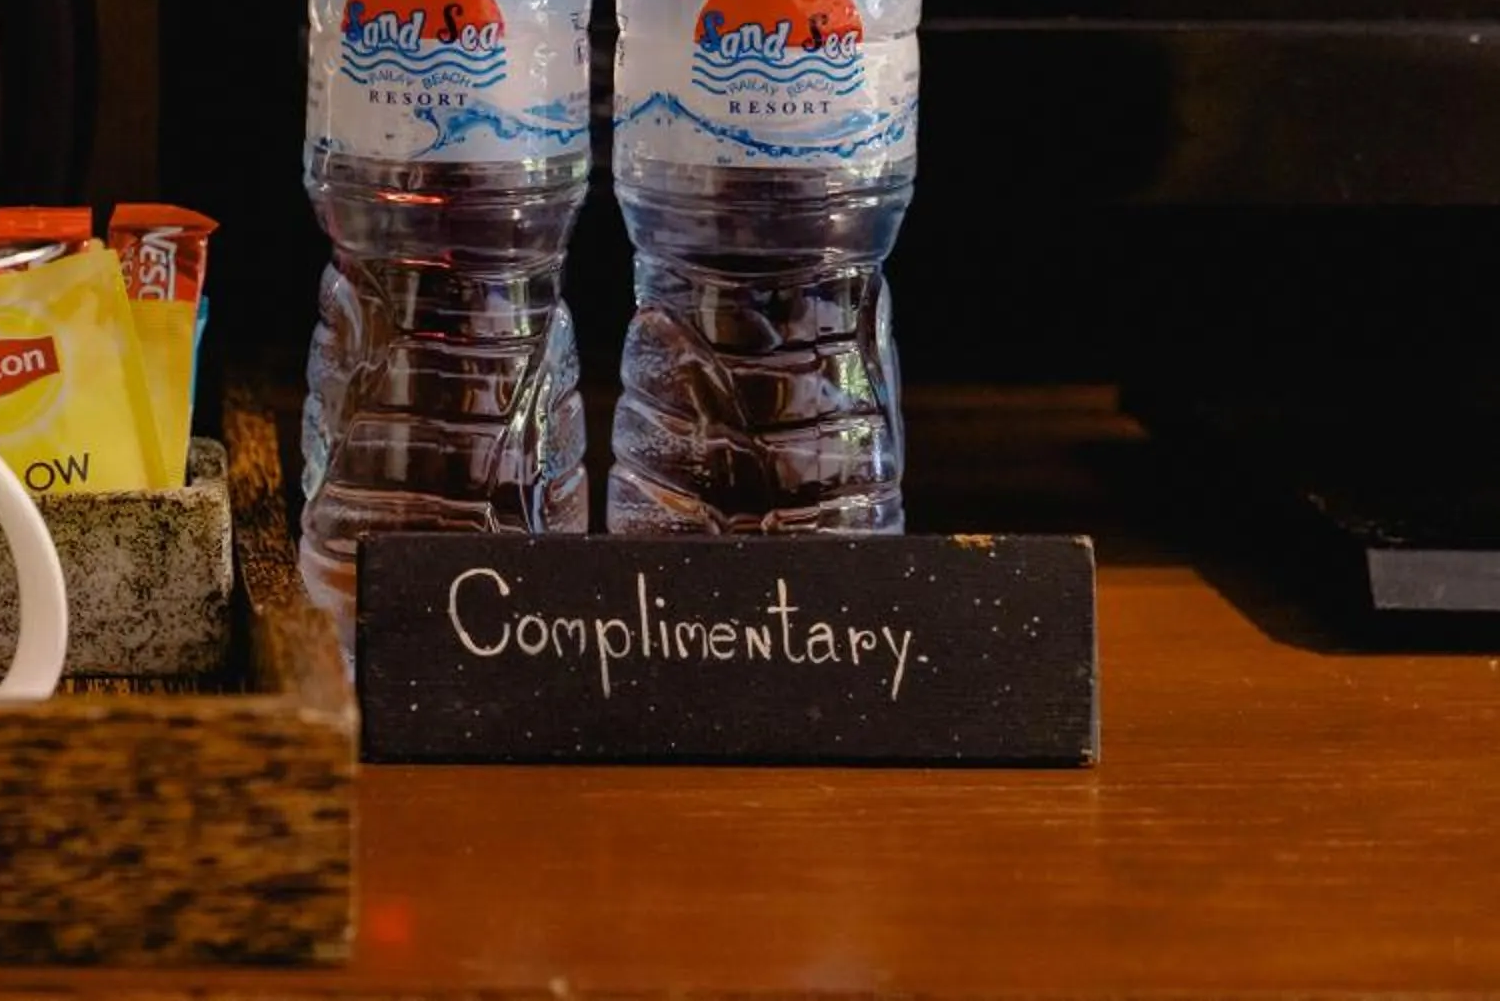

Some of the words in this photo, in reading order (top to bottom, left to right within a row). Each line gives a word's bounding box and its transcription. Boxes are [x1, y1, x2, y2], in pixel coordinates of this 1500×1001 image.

[344, 0, 426, 51] Sand
[435, 2, 502, 52] Sea
[700, 10, 791, 61] Sand
[801, 13, 858, 59] Sea
[368, 89, 470, 106] RESORT
[421, 70, 472, 90] BEACH
[786, 79, 836, 98] BEACH
[729, 101, 831, 114] RESORT
[139, 227, 183, 300] NESC
[449, 567, 929, 701] Complimentary.
